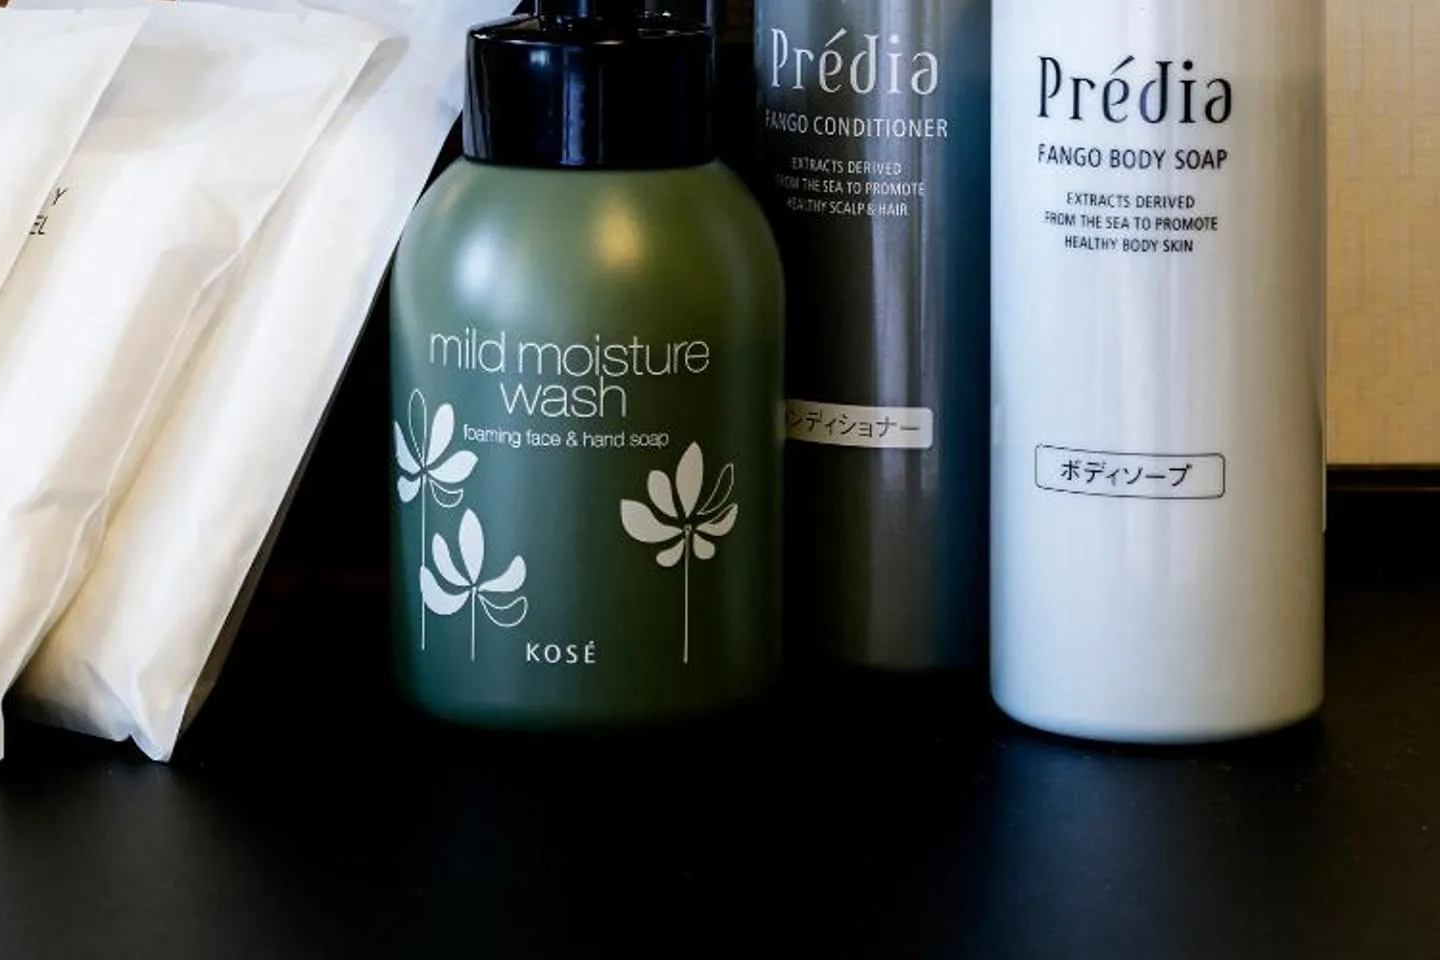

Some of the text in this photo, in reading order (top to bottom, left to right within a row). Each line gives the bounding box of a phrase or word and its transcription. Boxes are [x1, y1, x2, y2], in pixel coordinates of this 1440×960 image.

[770, 27, 939, 95] Prédia
[1037, 54, 1232, 124] Prédia
[765, 108, 948, 138] FANGO CONDITIONER
[791, 156, 902, 176] EXTRACTS DERIVED
[1037, 143, 1229, 171] FANGO BODY SOAP
[802, 177, 821, 193] THE
[823, 179, 844, 194] SEA
[847, 182, 861, 196] TO
[865, 182, 926, 197] PROMOTE
[828, 201, 864, 217] SCALP
[867, 204, 876, 215] &
[878, 203, 909, 217] HAIR
[1066, 192, 1196, 209] EXTRACTS DERIVED
[1044, 211, 1219, 231] FROM THE SEA TO PROMOTE
[1065, 235, 1194, 253] HEALTHY BODY SKIN
[430, 327, 710, 376] mild moisture
[500, 377, 627, 418] wash
[787, 408, 921, 438] ンディショナー
[463, 424, 669, 449] foaming face & hand soap
[1060, 459, 1193, 487] ボディソープ
[526, 640, 597, 664] KOSÉ
